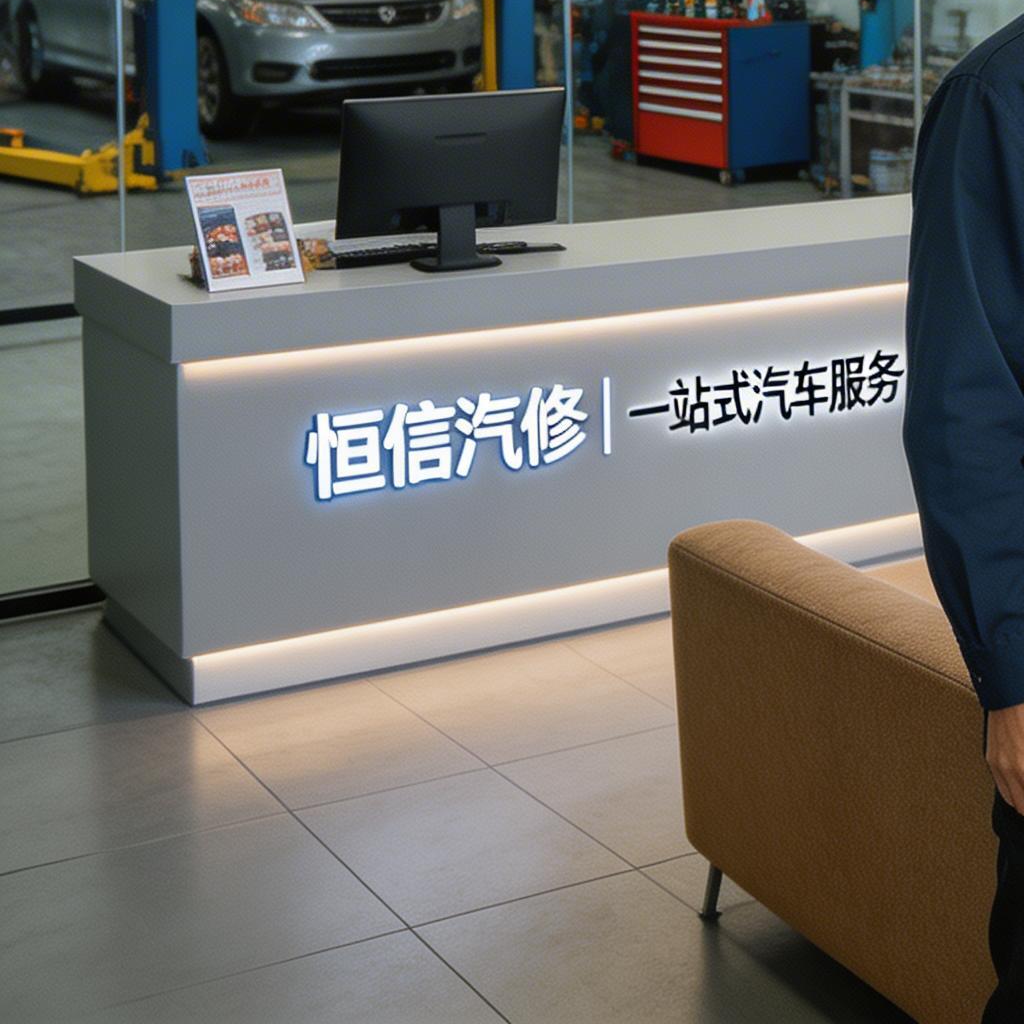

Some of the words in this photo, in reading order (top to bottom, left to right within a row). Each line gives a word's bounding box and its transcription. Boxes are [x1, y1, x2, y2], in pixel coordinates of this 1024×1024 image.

[305, 383, 588, 500] 恒信汽修
[628, 349, 905, 435] 一站式汽车服务
